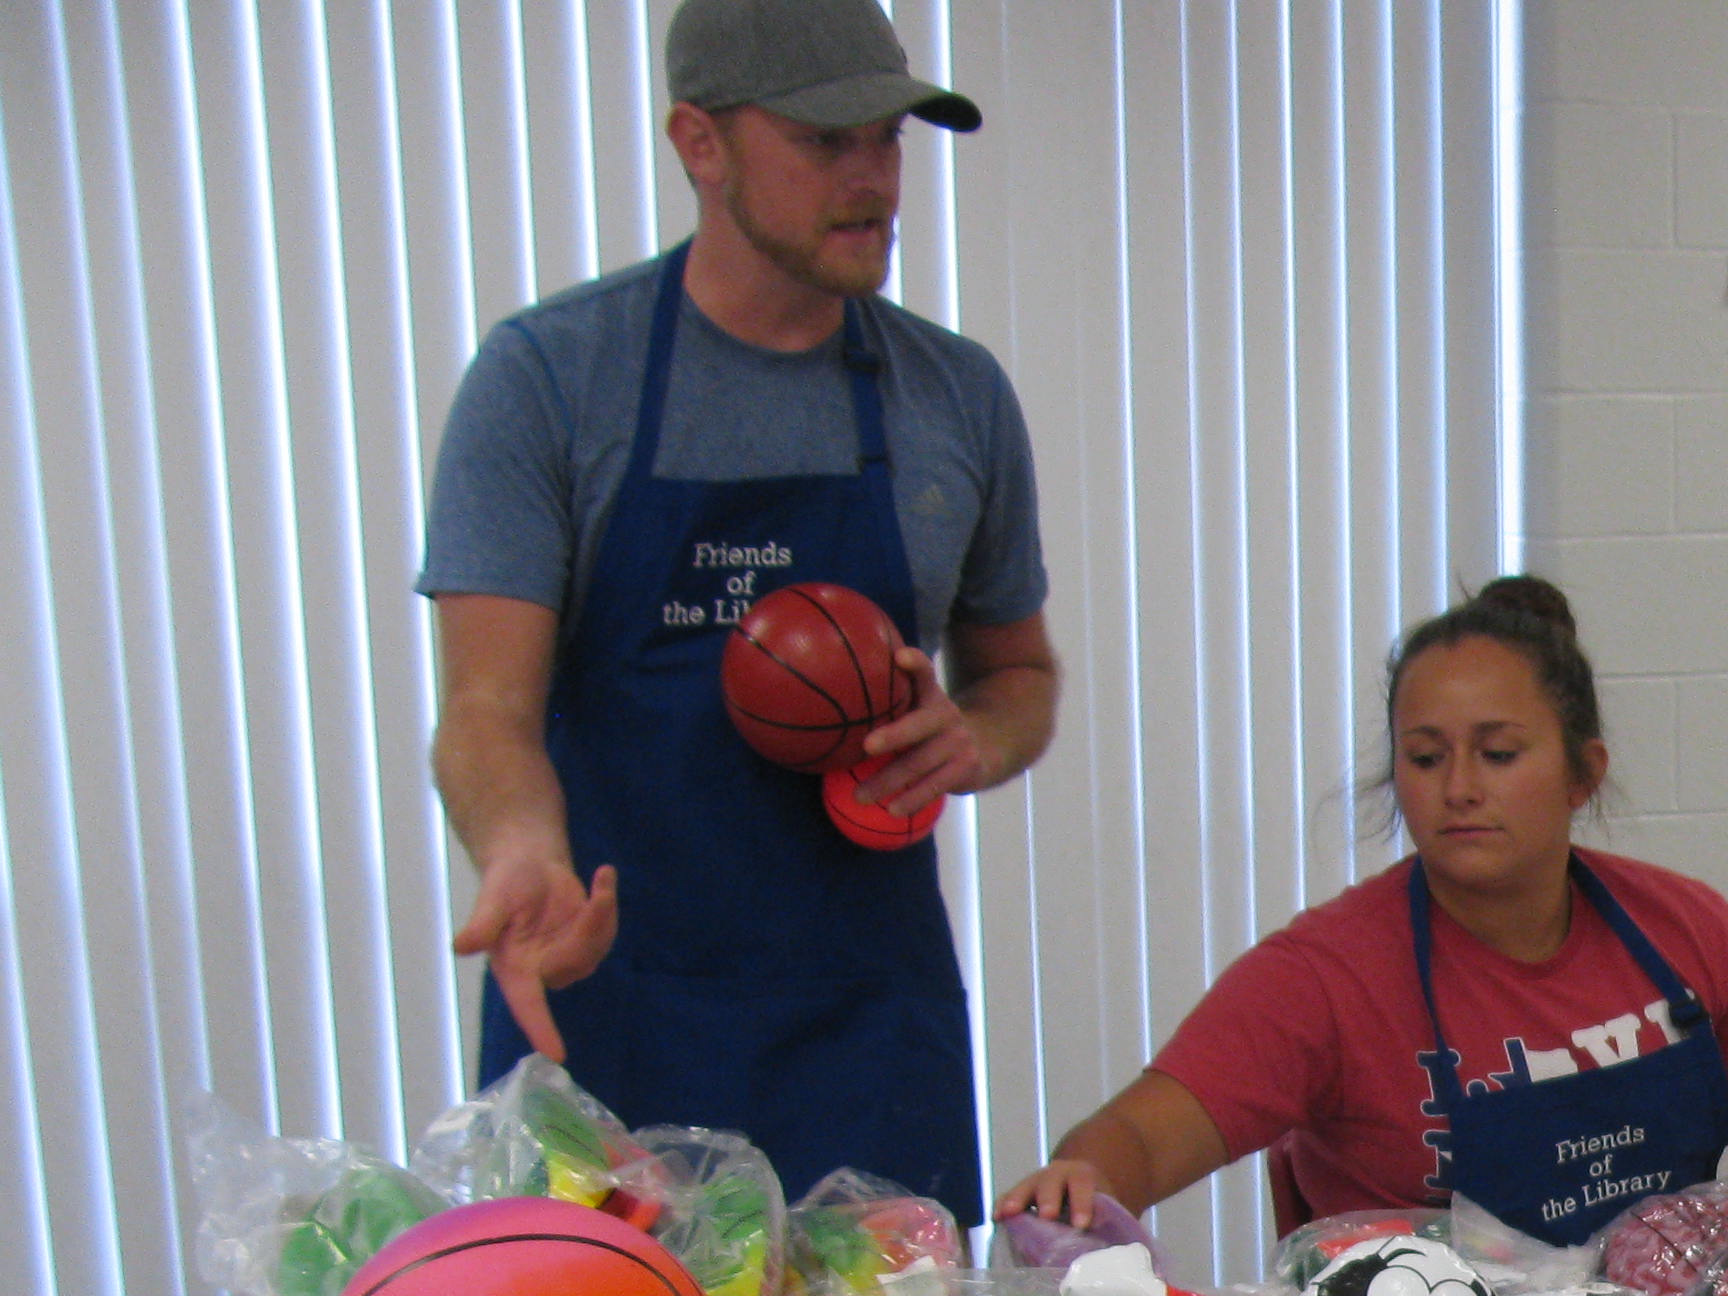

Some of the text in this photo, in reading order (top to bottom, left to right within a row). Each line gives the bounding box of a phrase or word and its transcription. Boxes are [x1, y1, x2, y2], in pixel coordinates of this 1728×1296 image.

[693, 541, 792, 567] Friends
[726, 569, 756, 595] of
[663, 600, 706, 625] the
[1555, 1125, 1645, 1164] Friends
[1589, 1153, 1613, 1177] of
[1541, 1170, 1672, 1221] the Library
